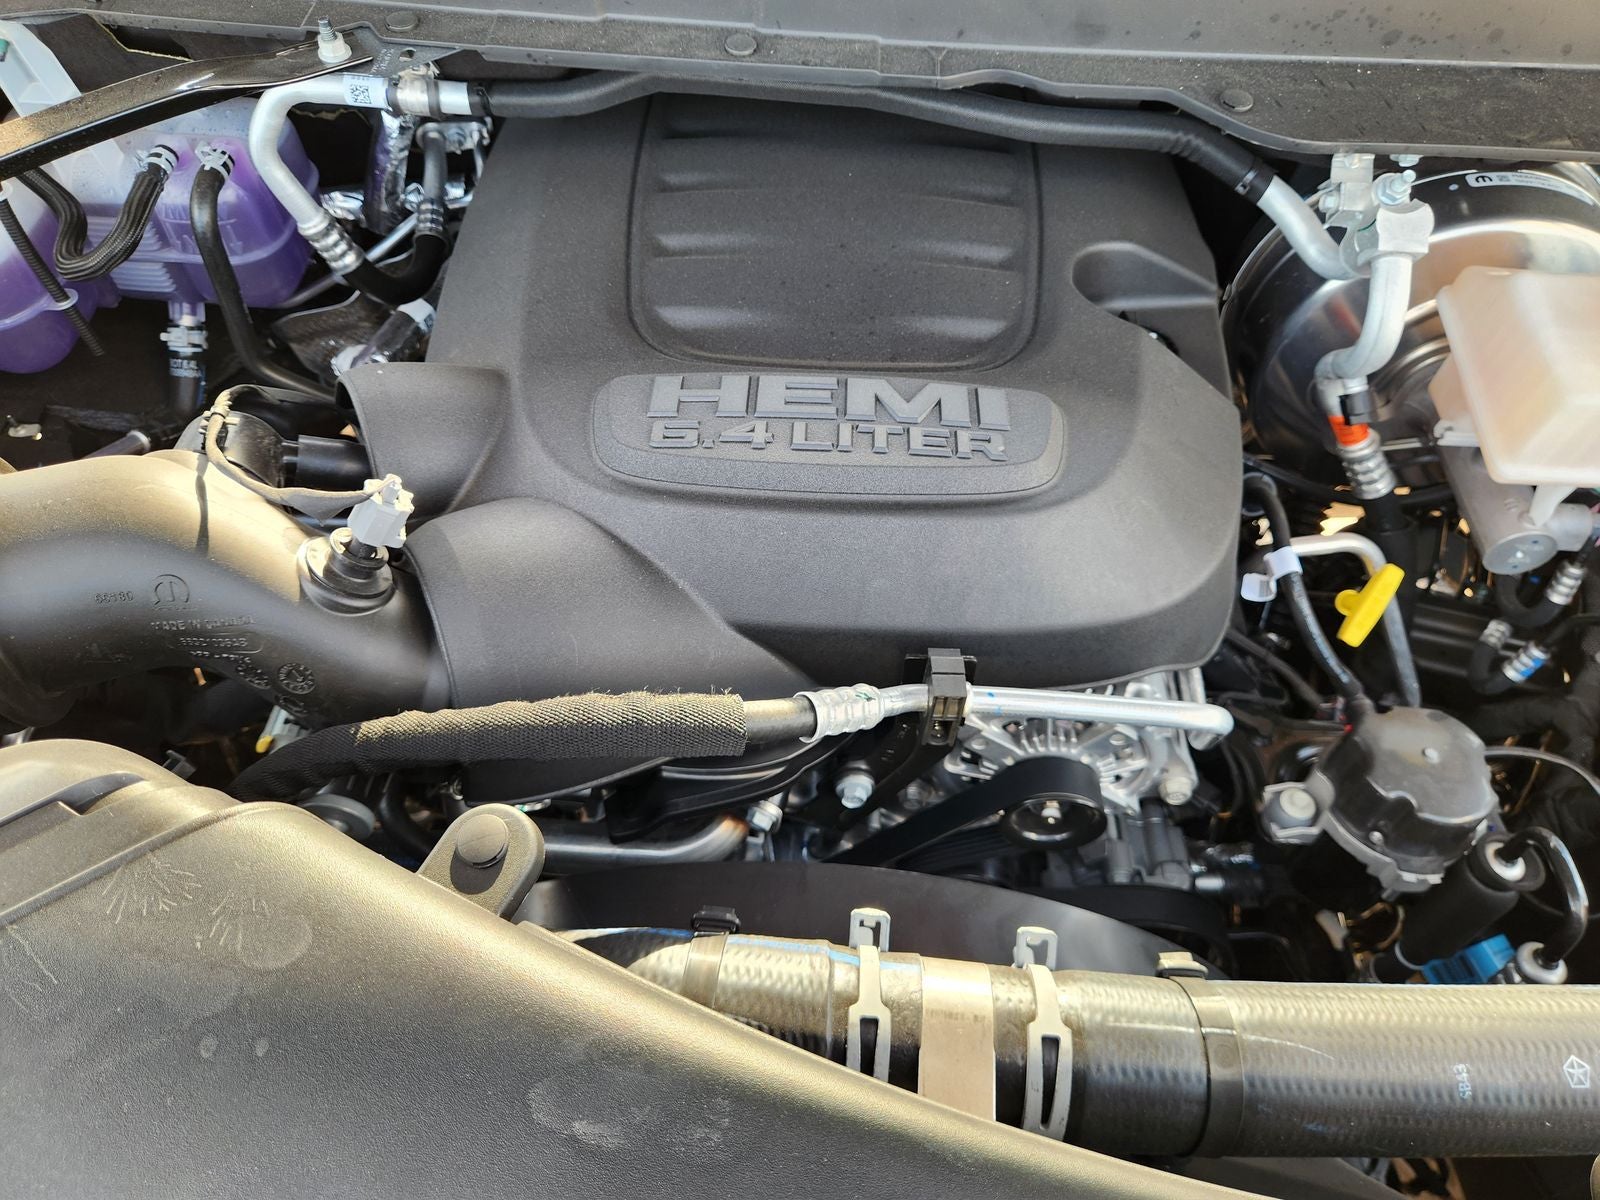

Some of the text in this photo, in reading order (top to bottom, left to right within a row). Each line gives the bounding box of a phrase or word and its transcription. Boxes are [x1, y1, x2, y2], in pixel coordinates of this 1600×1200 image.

[646, 375, 1011, 431] HEMI
[649, 419, 1008, 461] 6.4 LITER
